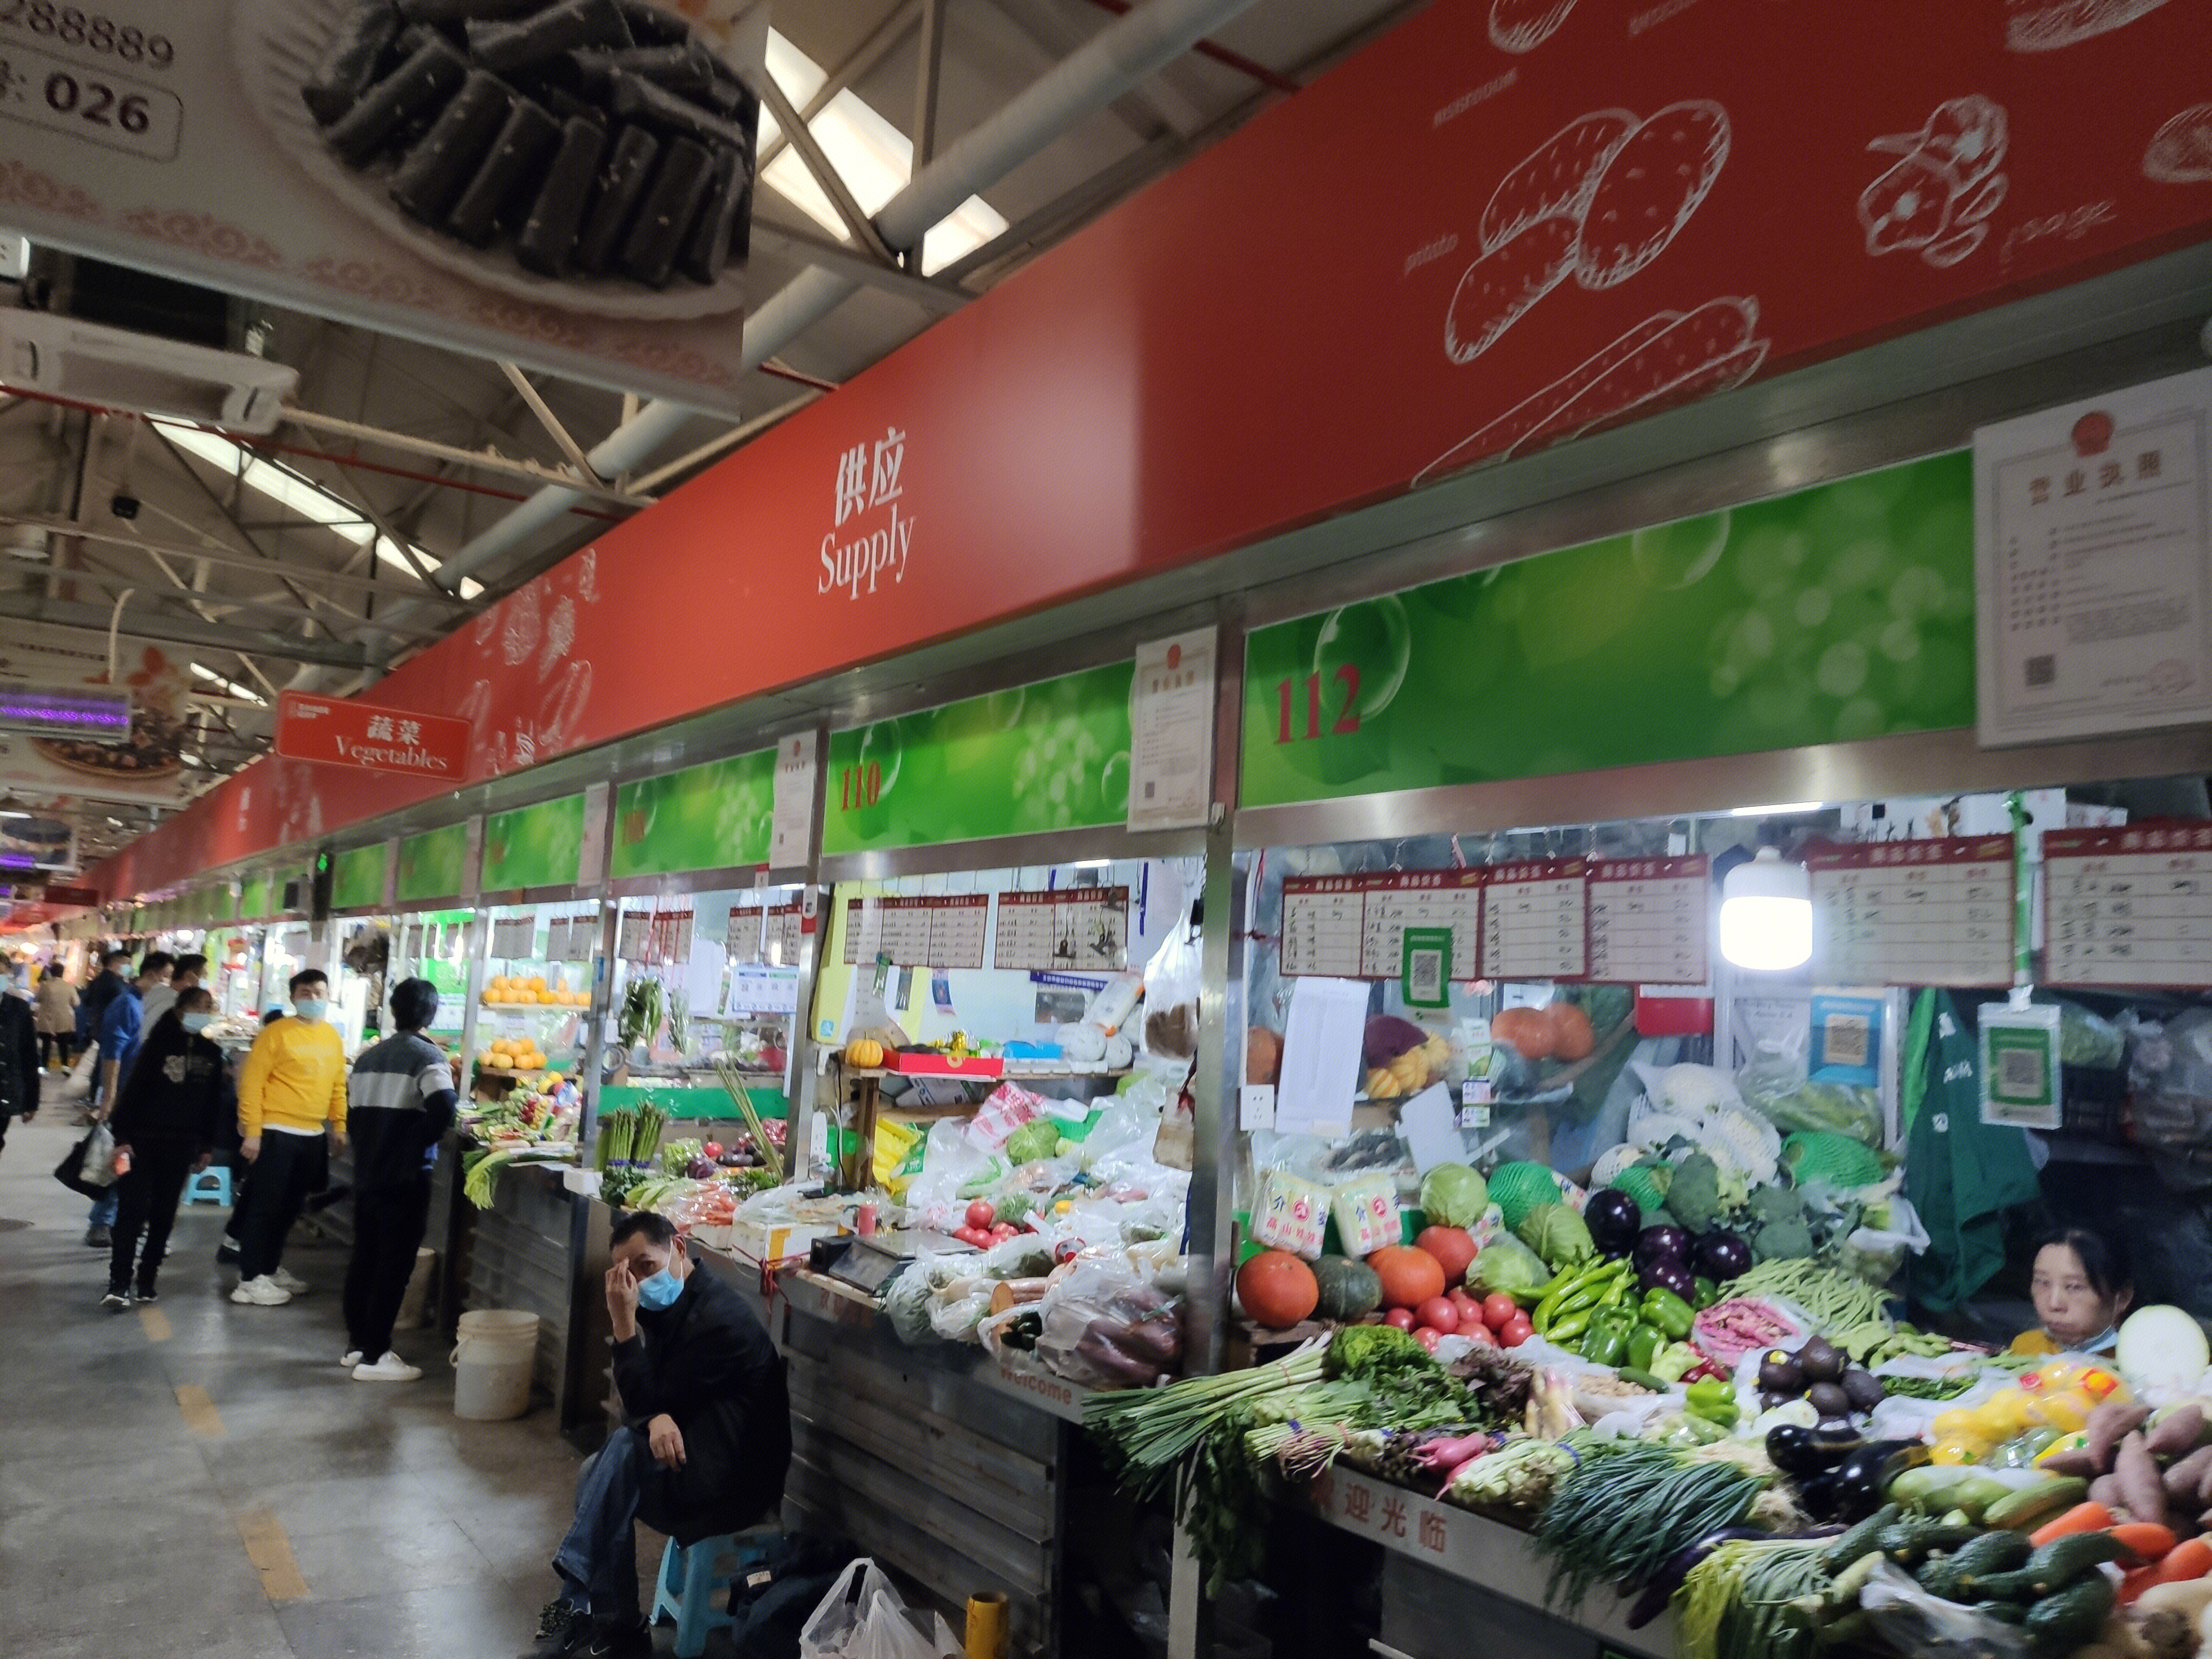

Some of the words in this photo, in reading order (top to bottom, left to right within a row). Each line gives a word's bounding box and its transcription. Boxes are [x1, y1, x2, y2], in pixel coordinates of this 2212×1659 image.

[45, 72, 149, 134] 026
[834, 426, 906, 527] 供应
[818, 503, 916, 601] Supply
[367, 715, 422, 745] 蔬菜
[1274, 662, 1361, 744] 112
[335, 734, 447, 769] Vegetables
[841, 760, 881, 811] 110
